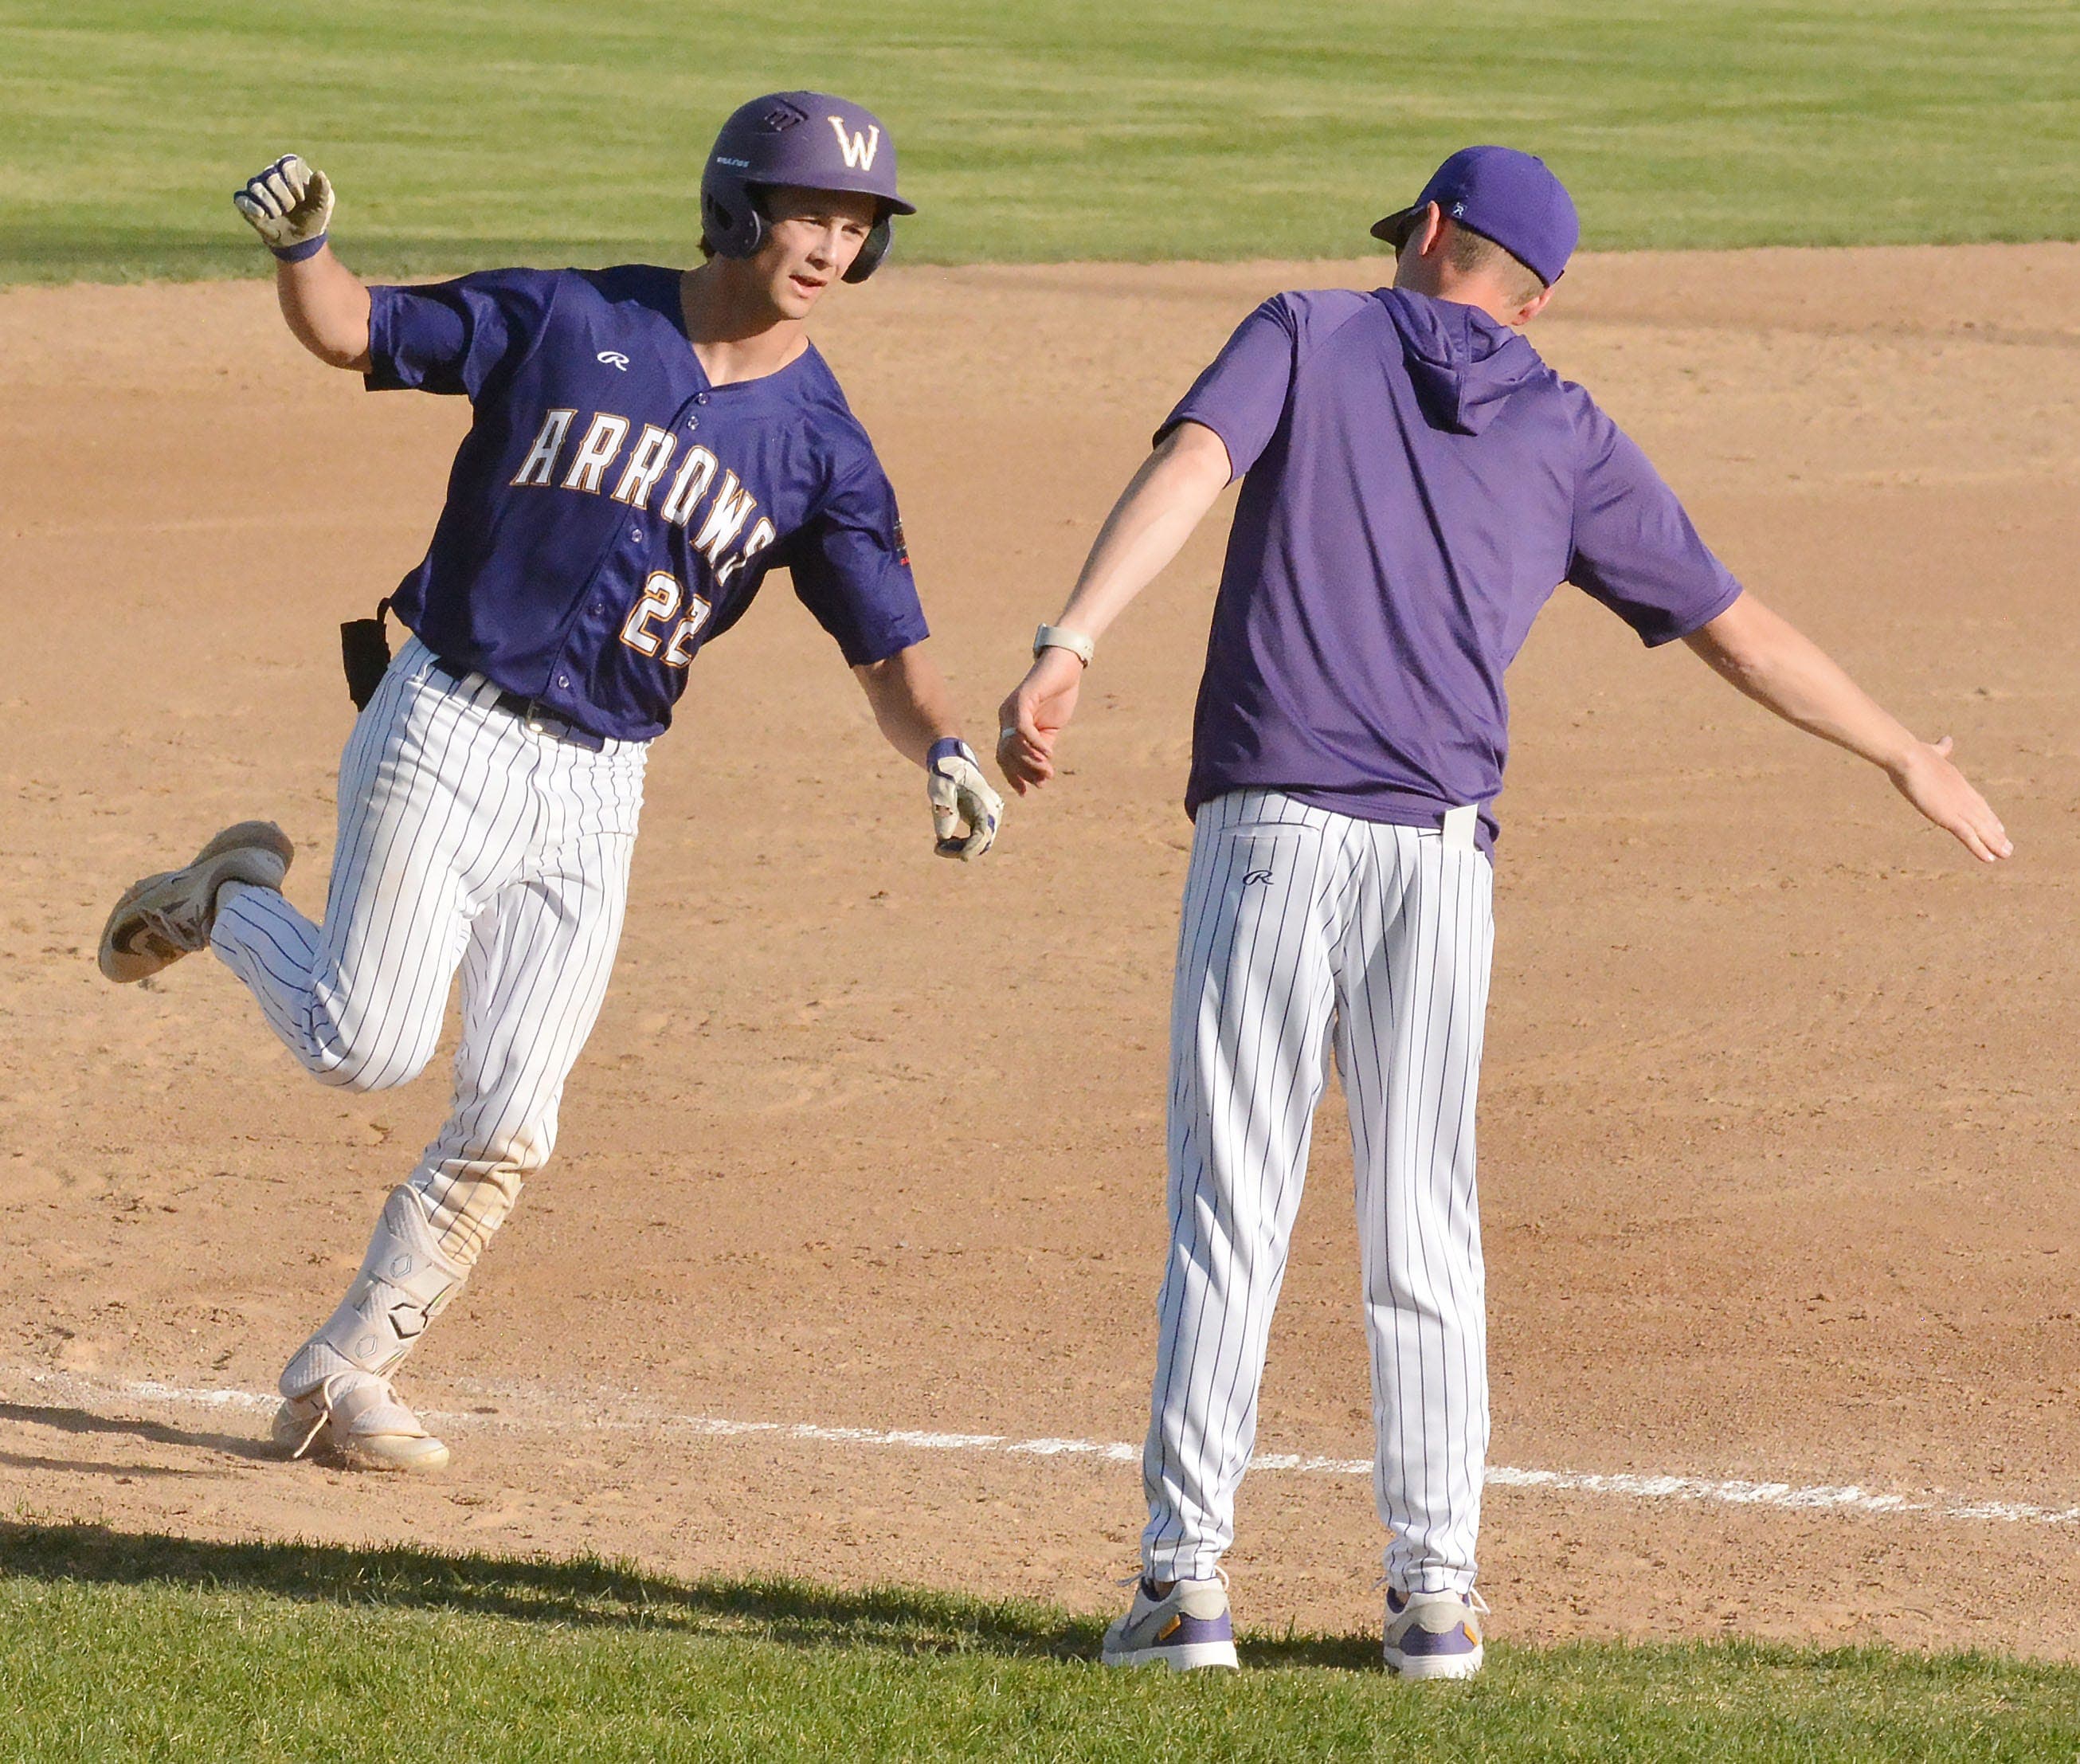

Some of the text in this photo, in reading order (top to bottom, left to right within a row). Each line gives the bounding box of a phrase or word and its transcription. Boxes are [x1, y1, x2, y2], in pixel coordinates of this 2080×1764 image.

[828, 116, 879, 171] W
[510, 409, 776, 586] ARROWS
[621, 570, 711, 667] 22
